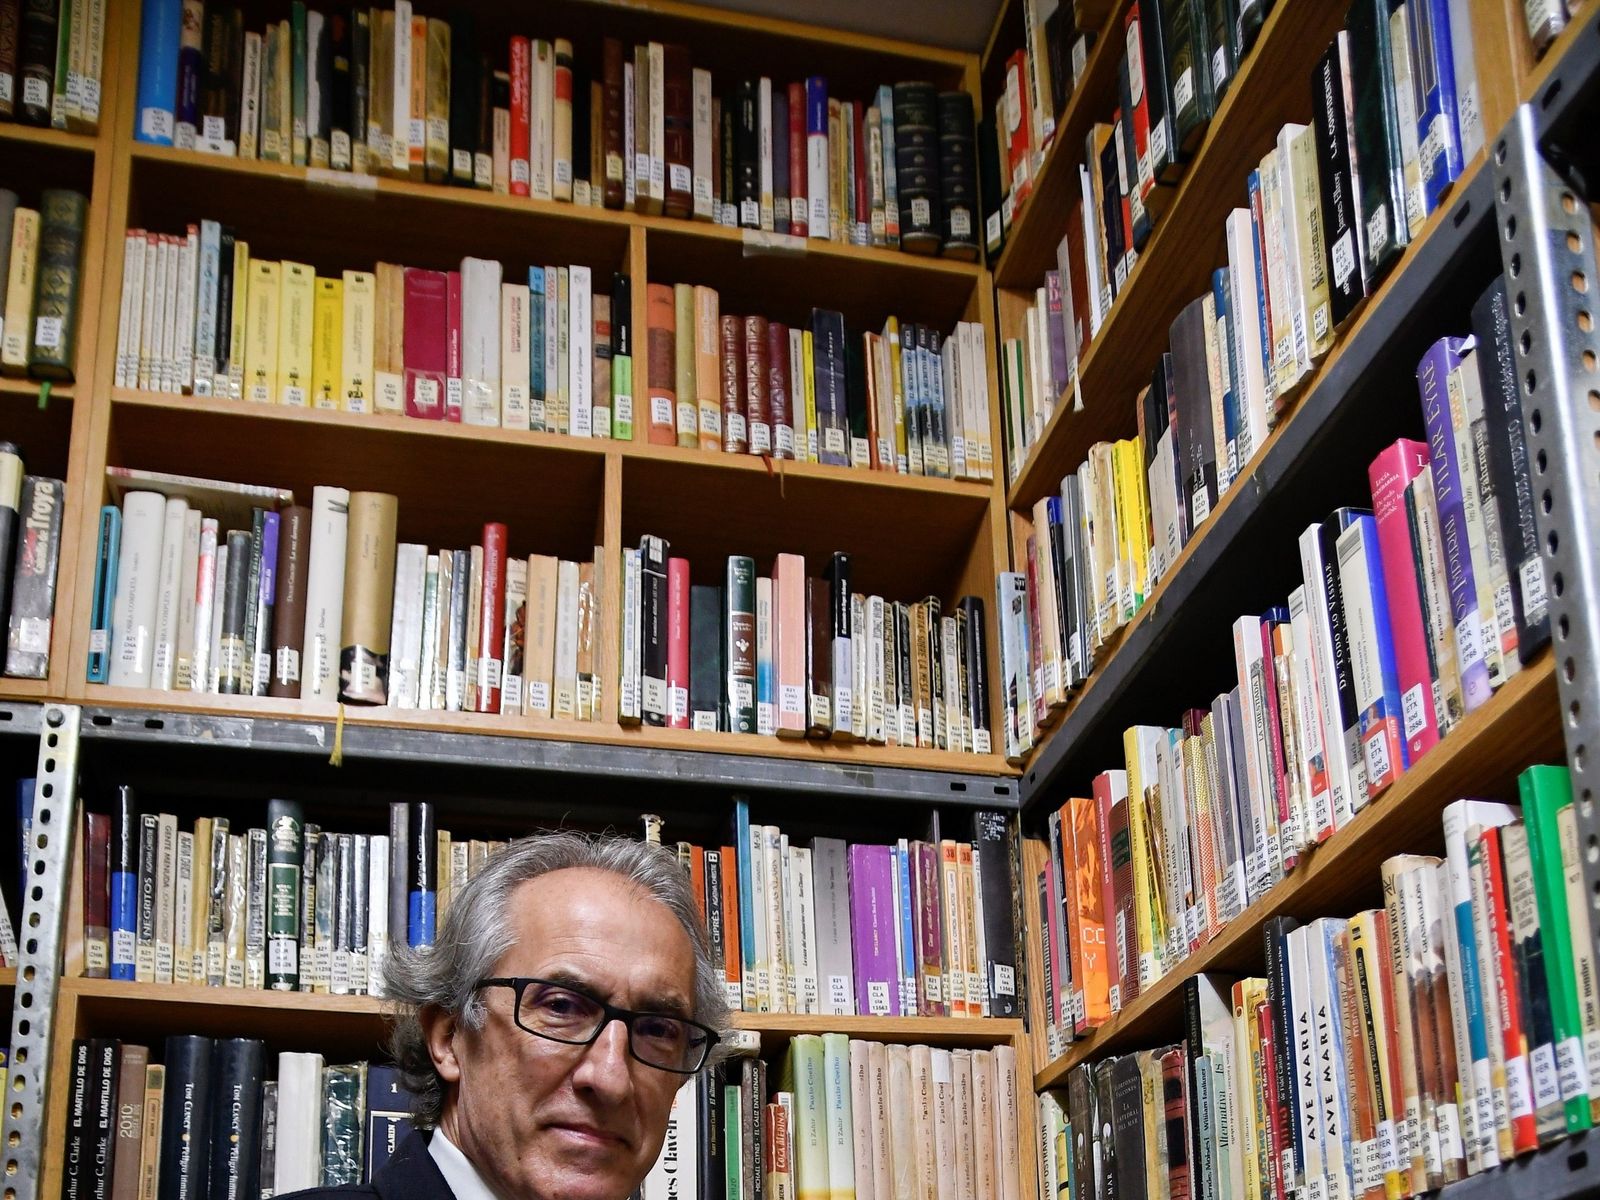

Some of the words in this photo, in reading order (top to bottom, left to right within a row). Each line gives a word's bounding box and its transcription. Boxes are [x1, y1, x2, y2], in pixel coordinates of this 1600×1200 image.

[1424, 359, 1440, 425] EYRE
[1431, 424, 1451, 501] PILAR
[1325, 563, 1336, 611] VISIBLE
[1335, 633, 1343, 669] TODO
[1370, 738, 1380, 750] 821
[1371, 747, 1382, 760] ETX
[142, 878, 153, 937] NEGRITOS
[1390, 902, 1403, 975] EXTRAMUROS
[79, 1045, 87, 1066] DIOS
[104, 1047, 113, 1067] DIOS
[1299, 1011, 1312, 1087] MARIA
[1318, 1004, 1331, 1082] MARIA
[74, 1077, 84, 1118] MARTILLO
[101, 1078, 110, 1118] MARTILLO
[752, 1067, 760, 1110] ENVENENADO
[776, 1111, 786, 1143] MEDINA
[1217, 1091, 1229, 1149] Alternativa
[1305, 1099, 1316, 1141] AVE
[1325, 1094, 1337, 1136] AVE
[71, 1136, 80, 1164] Clarke
[97, 1137, 106, 1164] Clarke
[179, 1145, 190, 1175] Peligro
[777, 1143, 786, 1168] COCA
[1041, 1124, 1050, 1179] OSTRAKON
